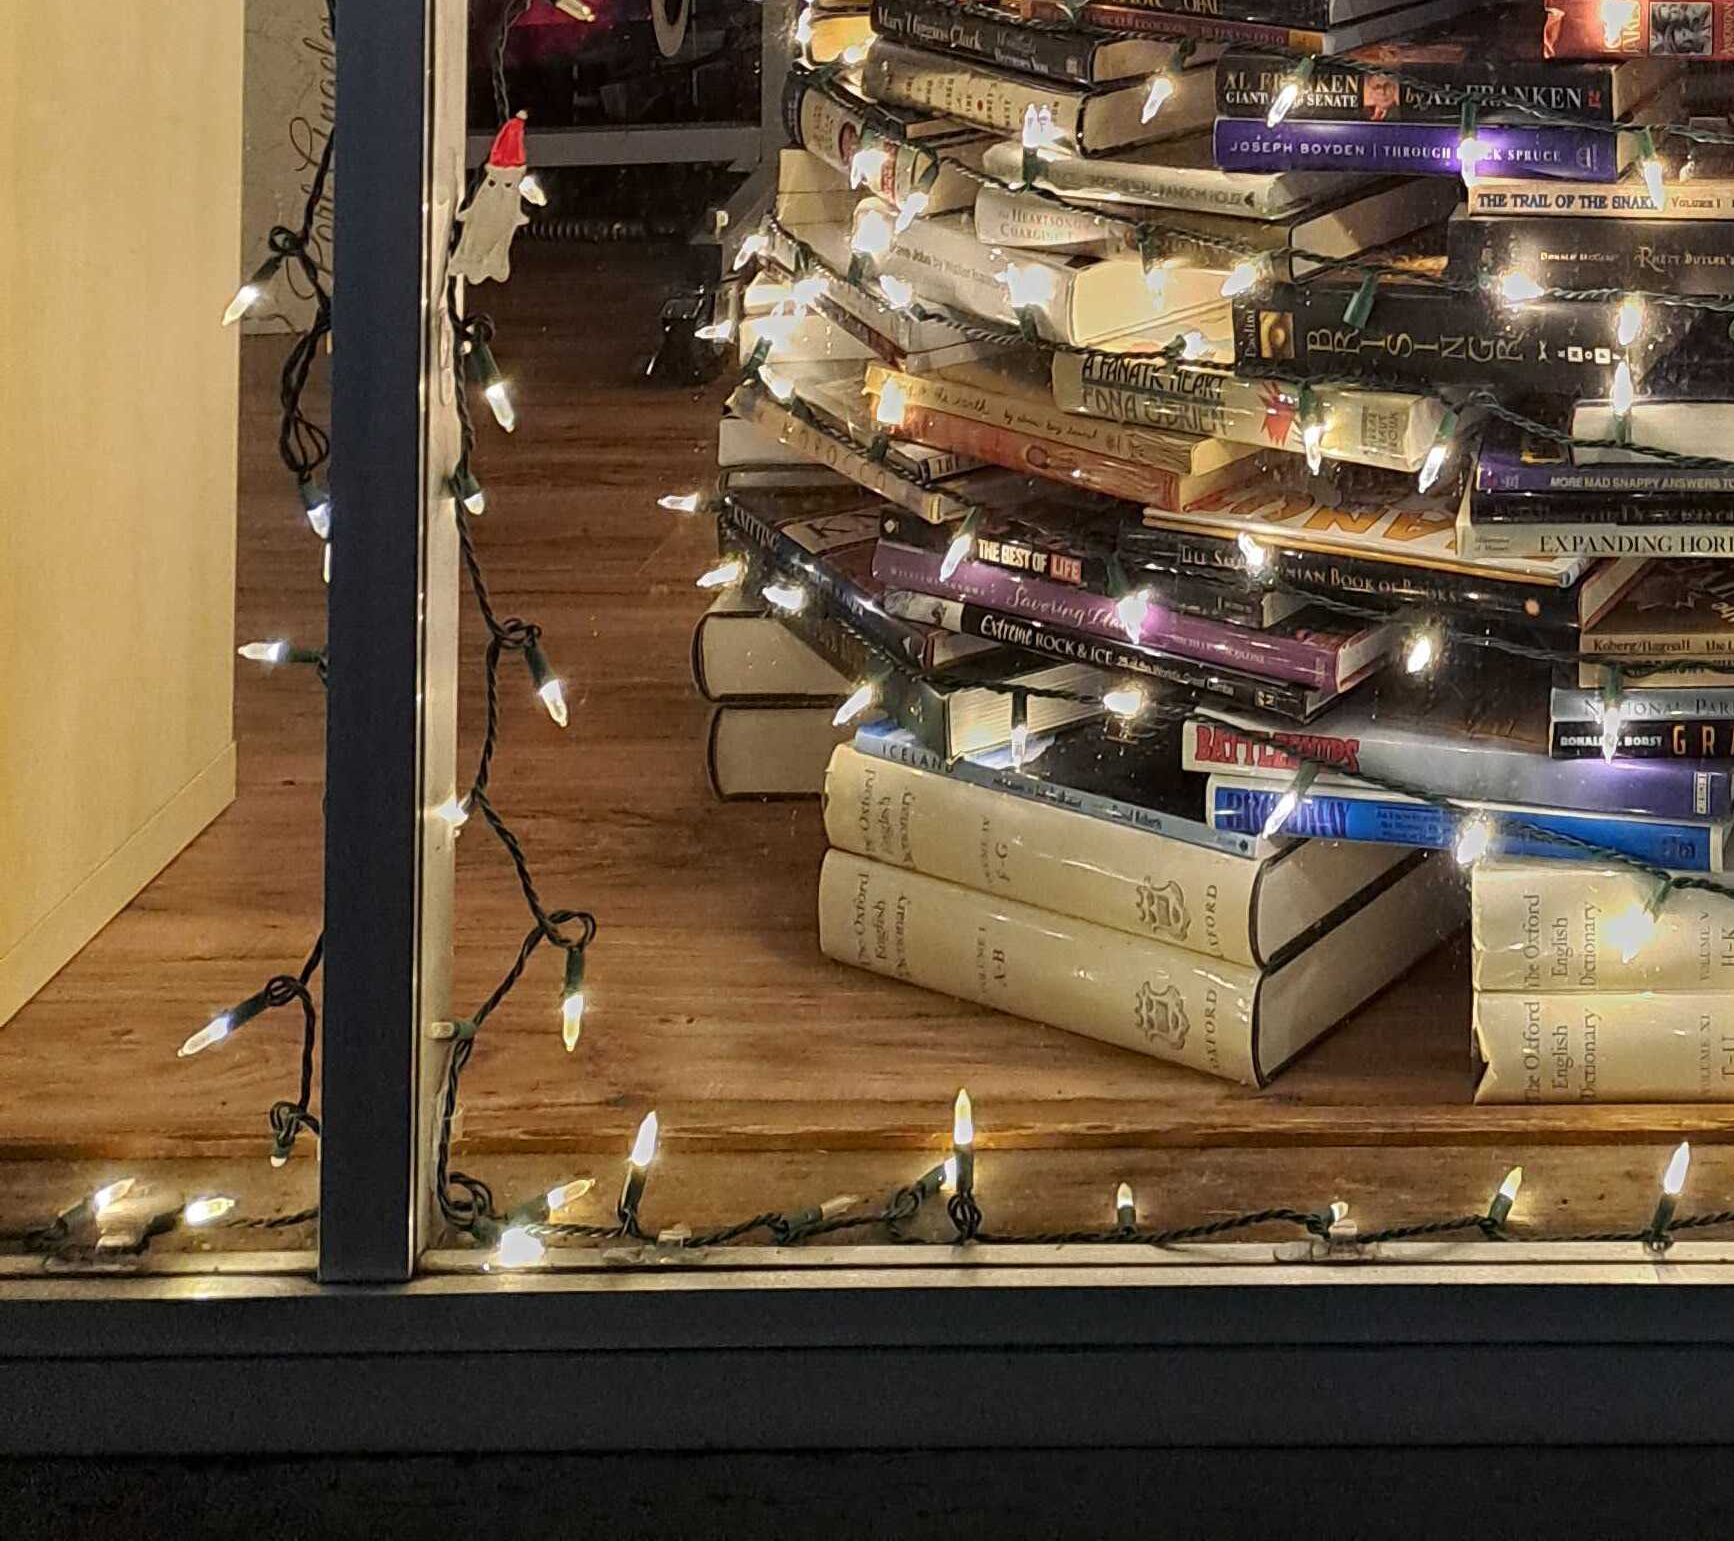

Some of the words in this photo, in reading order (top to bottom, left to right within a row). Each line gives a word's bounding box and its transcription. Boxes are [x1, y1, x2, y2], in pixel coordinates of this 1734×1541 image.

[1306, 93, 1360, 108] SENATE
[1229, 140, 1294, 155] JOSEPH
[1300, 141, 1366, 157] BOYDEN
[1383, 144, 1451, 159] THROUGH
[1507, 148, 1562, 163] SPRUCE
[1478, 192, 1508, 208] THE
[1510, 193, 1550, 209] TRAIL
[1555, 193, 1575, 209] OF
[1578, 193, 1608, 209] THE
[1307, 326, 1525, 363] BRISINGR
[977, 539, 1000, 562] THE
[1001, 543, 1029, 568] BEST
[1050, 553, 1082, 584] LIFE
[1539, 533, 1673, 555] EXPANDING
[1035, 625, 1074, 656] ROCK
[1527, 893, 1542, 961] Oxford
[1580, 900, 1603, 989] Dictionary
[1552, 917, 1570, 979] English
[1552, 1023, 1570, 1091] English
[1580, 1008, 1603, 1100] Dictionary
